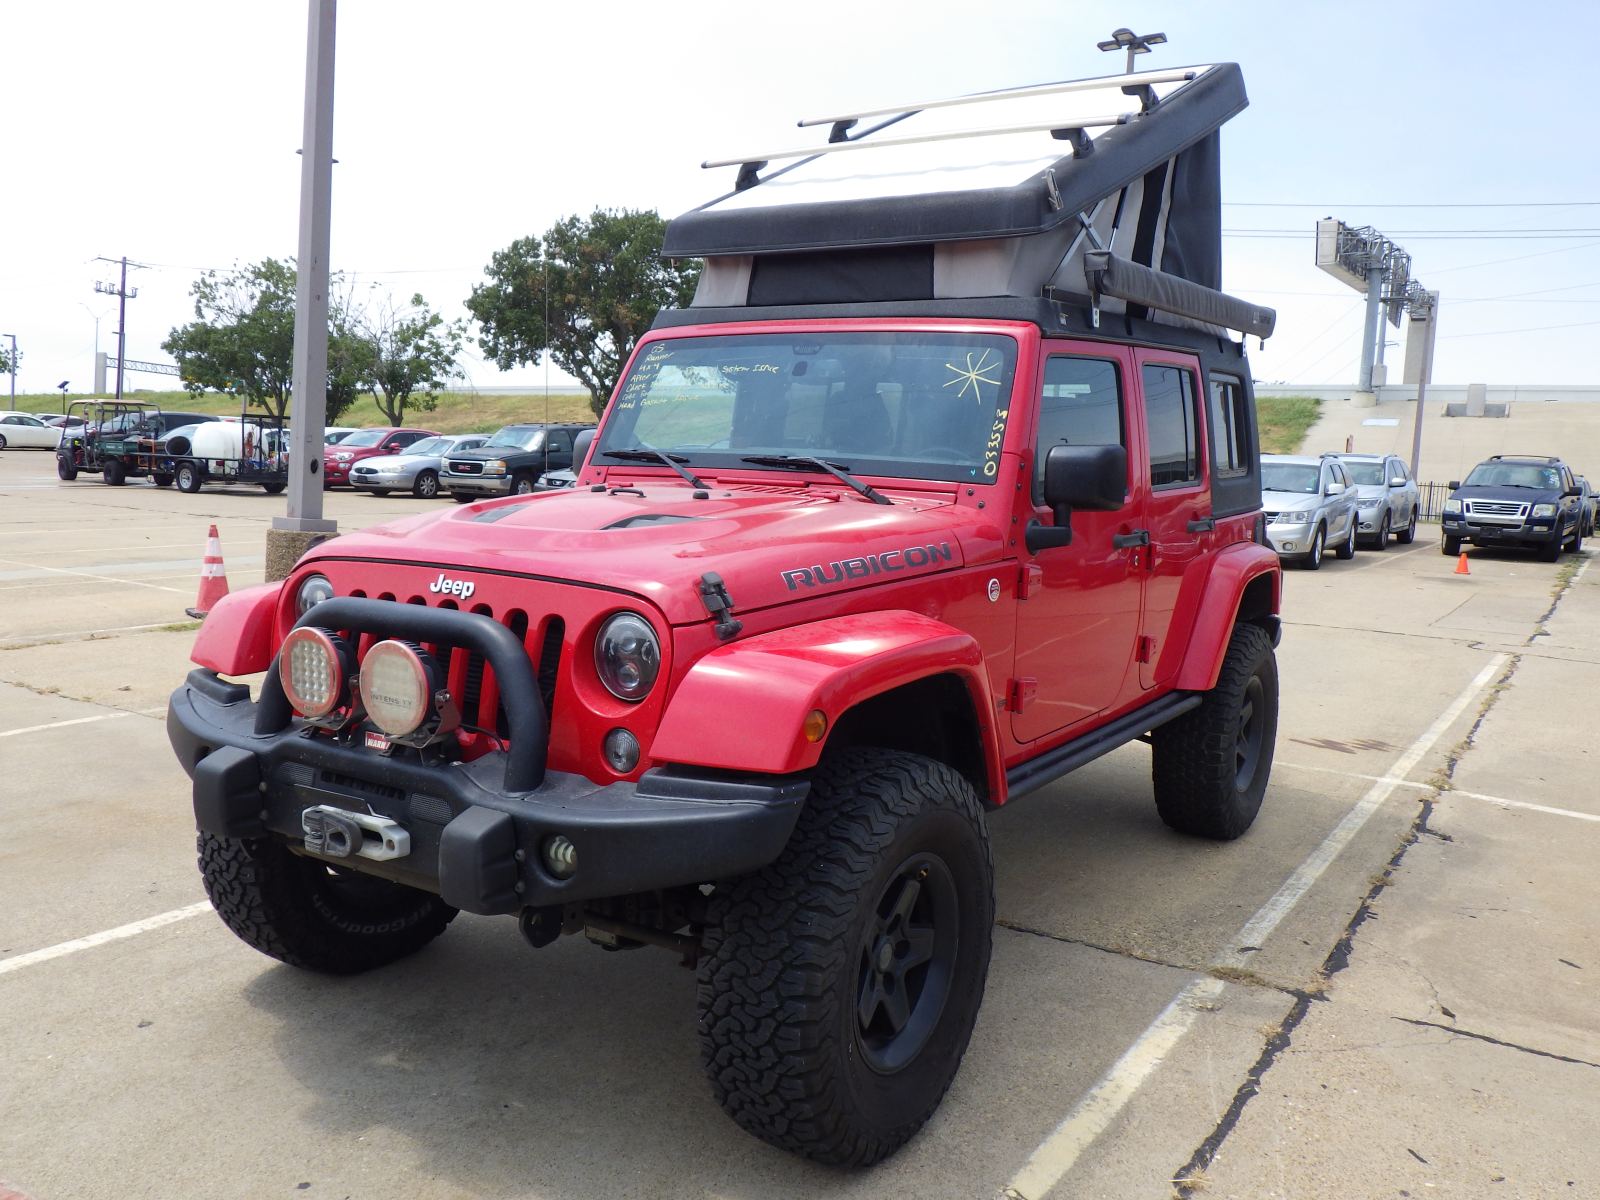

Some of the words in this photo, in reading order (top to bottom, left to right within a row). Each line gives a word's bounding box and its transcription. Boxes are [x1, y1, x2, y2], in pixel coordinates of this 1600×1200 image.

[781, 541, 953, 591] RUBICON
[430, 573, 475, 600] Jeep
[371, 694, 412, 705] INTENSTY
[367, 738, 387, 750] WARN
